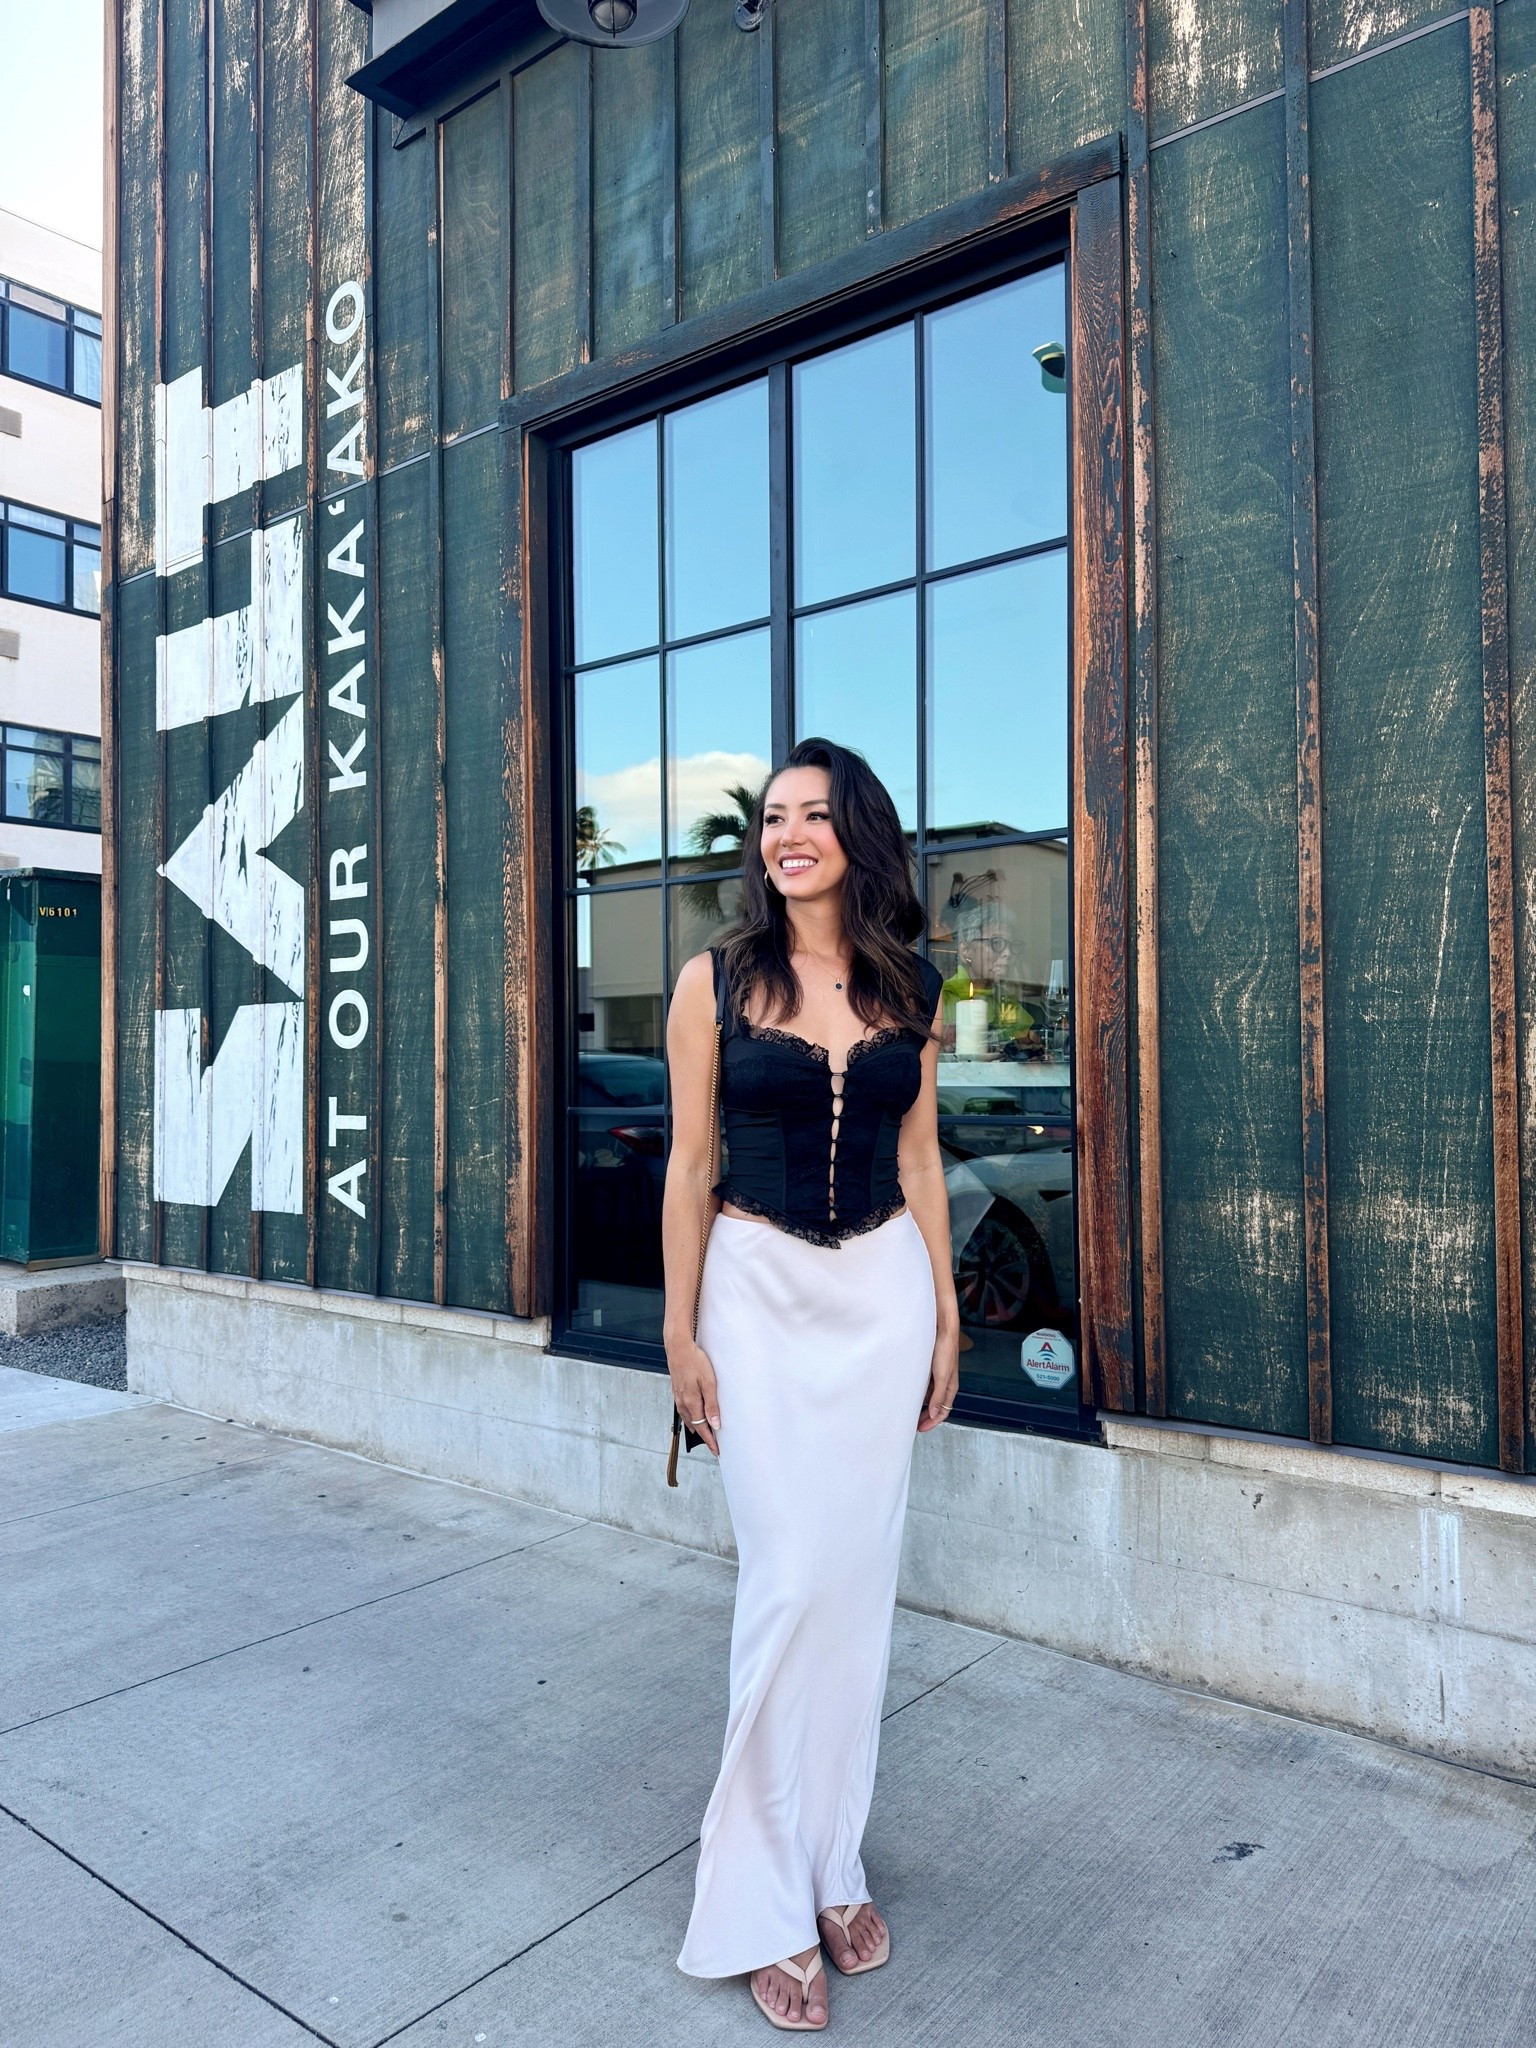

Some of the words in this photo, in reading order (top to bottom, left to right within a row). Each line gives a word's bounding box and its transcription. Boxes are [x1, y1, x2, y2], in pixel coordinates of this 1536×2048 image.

[154, 363, 305, 1215] SALT
[328, 843, 370, 1050] OUR
[328, 1096, 367, 1219] AT
[1027, 1358, 1070, 1372] AlertAlarm
